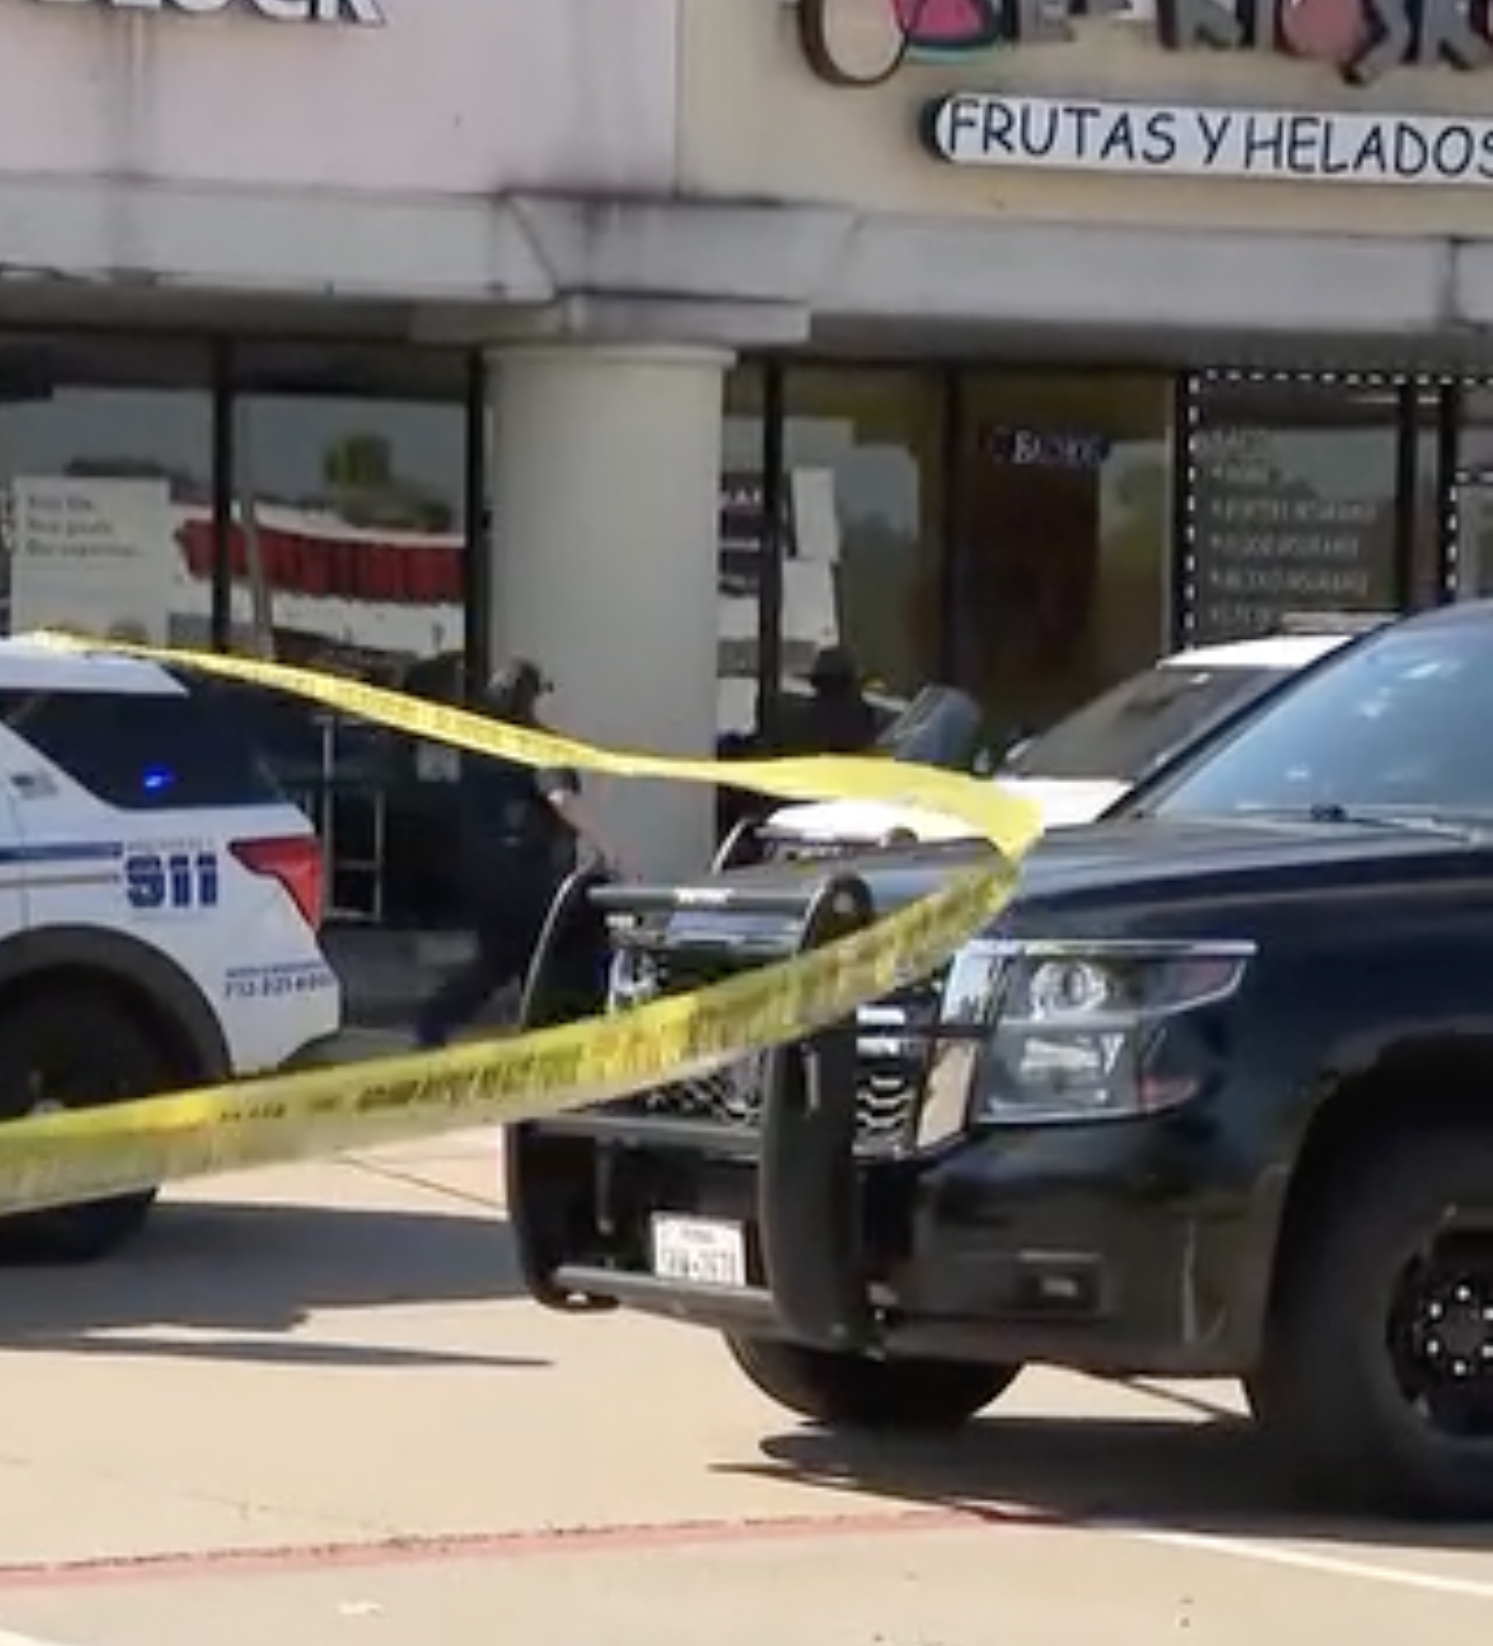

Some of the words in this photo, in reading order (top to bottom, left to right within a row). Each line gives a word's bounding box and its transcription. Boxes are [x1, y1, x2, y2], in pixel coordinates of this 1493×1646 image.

[945, 99, 1178, 163] FRUTAS
[1197, 115, 1232, 165] Y
[125, 854, 218, 908] 911
